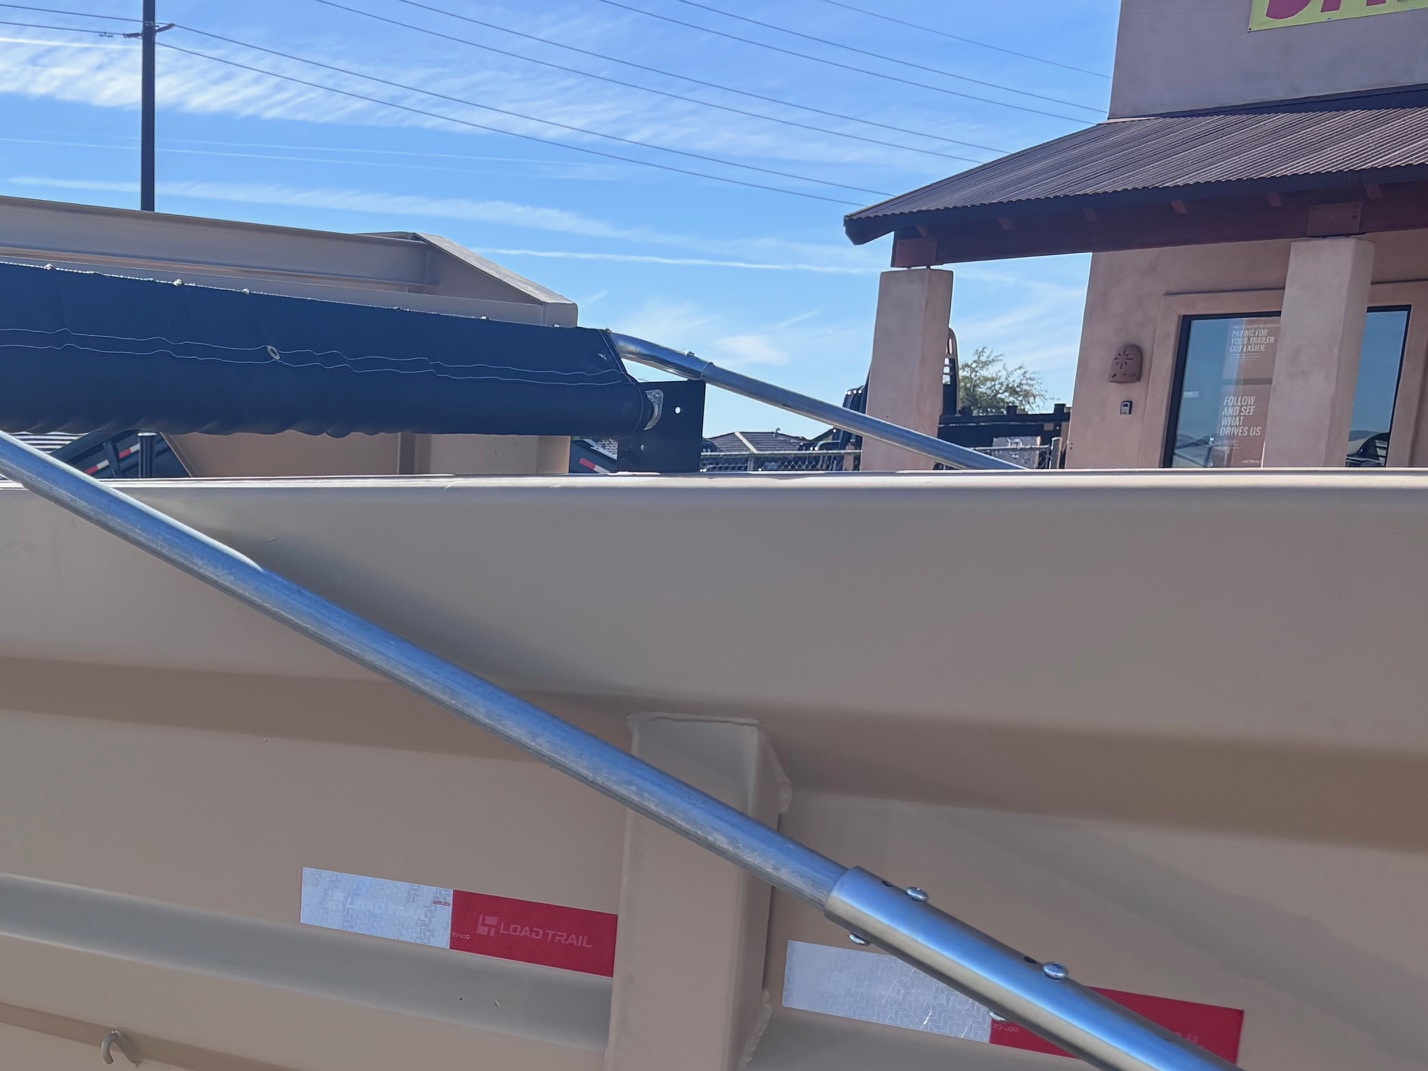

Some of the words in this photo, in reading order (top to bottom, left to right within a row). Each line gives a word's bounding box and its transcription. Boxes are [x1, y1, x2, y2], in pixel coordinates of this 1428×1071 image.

[1223, 396, 1256, 406] FOLLOW
[1222, 406, 1240, 416] AND
[1240, 406, 1255, 416] SEE
[1222, 416, 1244, 426] WHAT
[1220, 426, 1248, 436] DRIVES
[1249, 426, 1262, 436] US
[499, 921, 543, 940] LOAD
[544, 929, 592, 949] TRAIL
